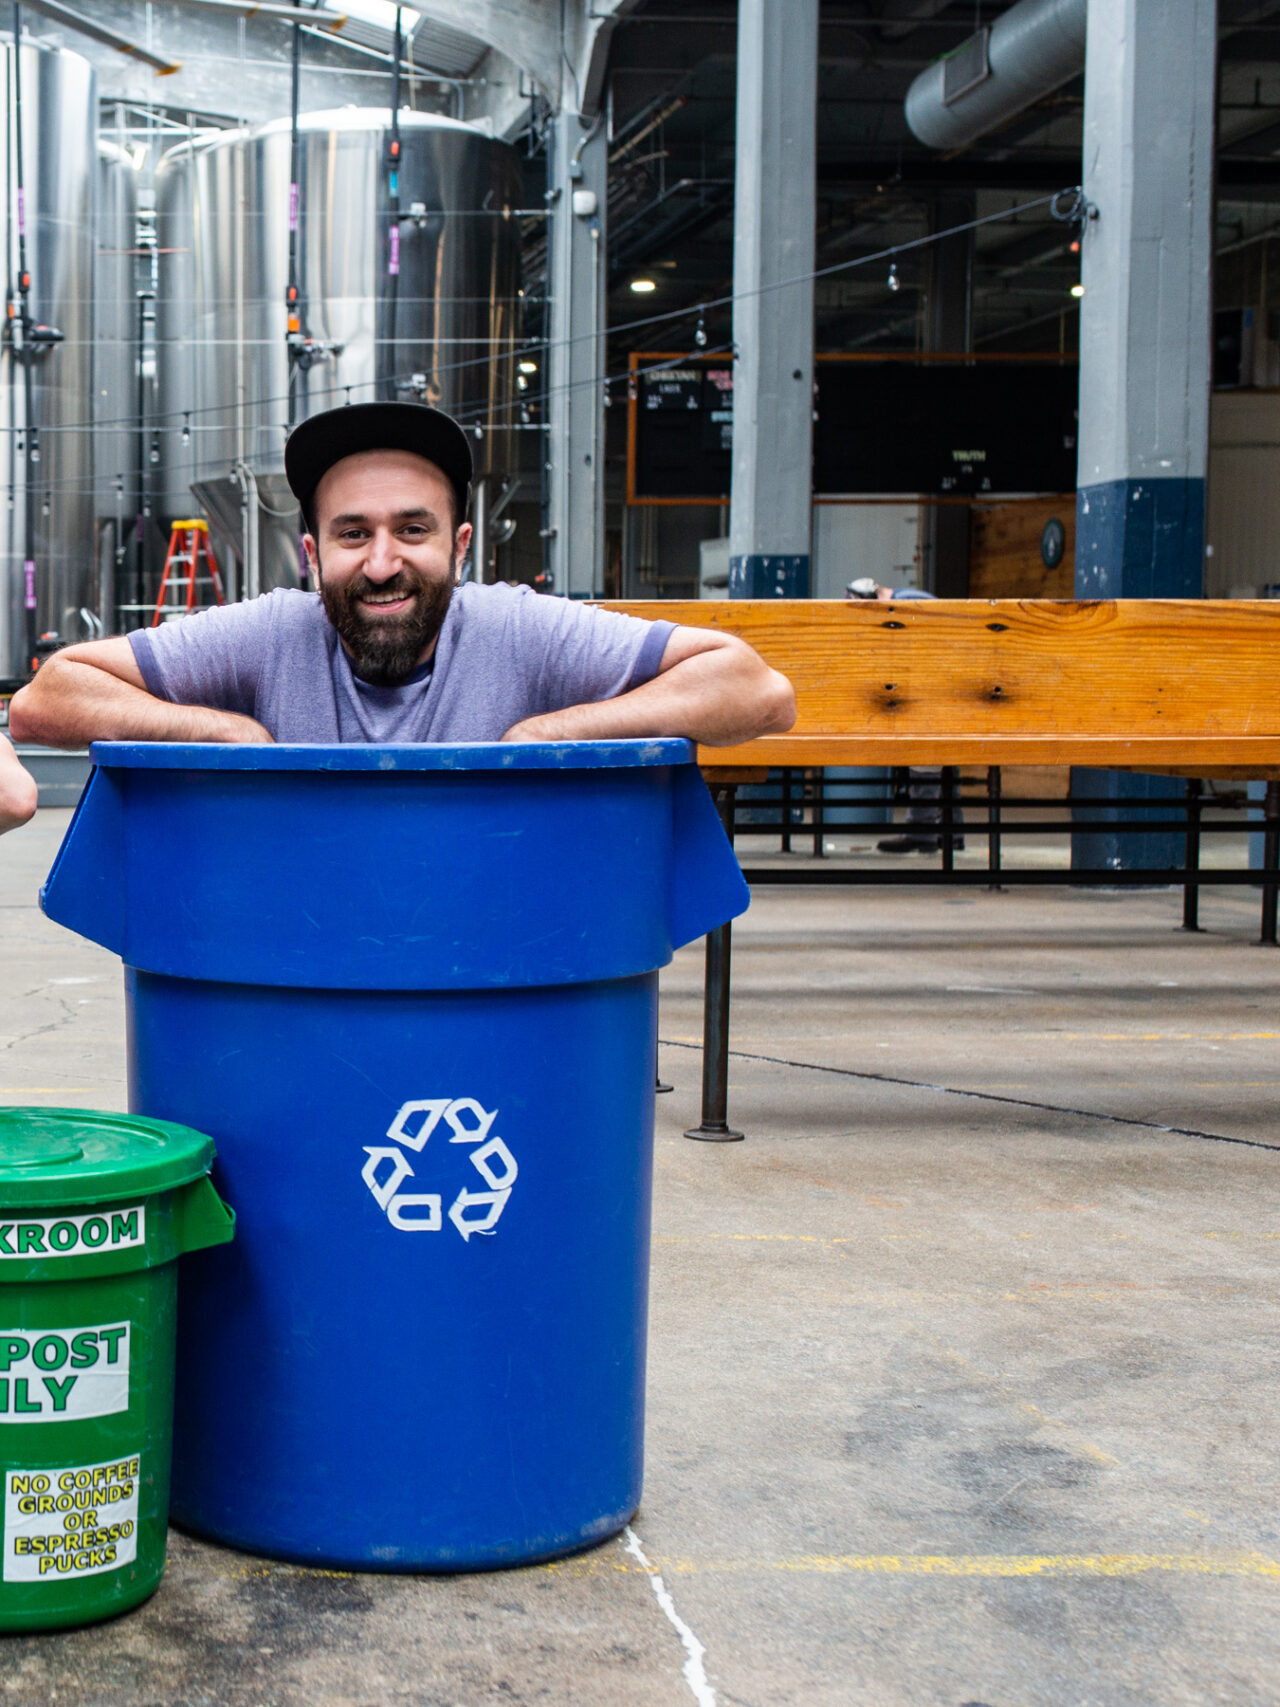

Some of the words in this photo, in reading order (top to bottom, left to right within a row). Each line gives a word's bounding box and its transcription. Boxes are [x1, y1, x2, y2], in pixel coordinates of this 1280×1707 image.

[11, 1474, 51, 1494] NO
[58, 1458, 139, 1491] COFFEE
[18, 1480, 133, 1514] GROUNDS
[14, 1519, 134, 1555] ESPRESSO
[63, 1510, 98, 1531] OR
[39, 1544, 117, 1574] PUCKS
